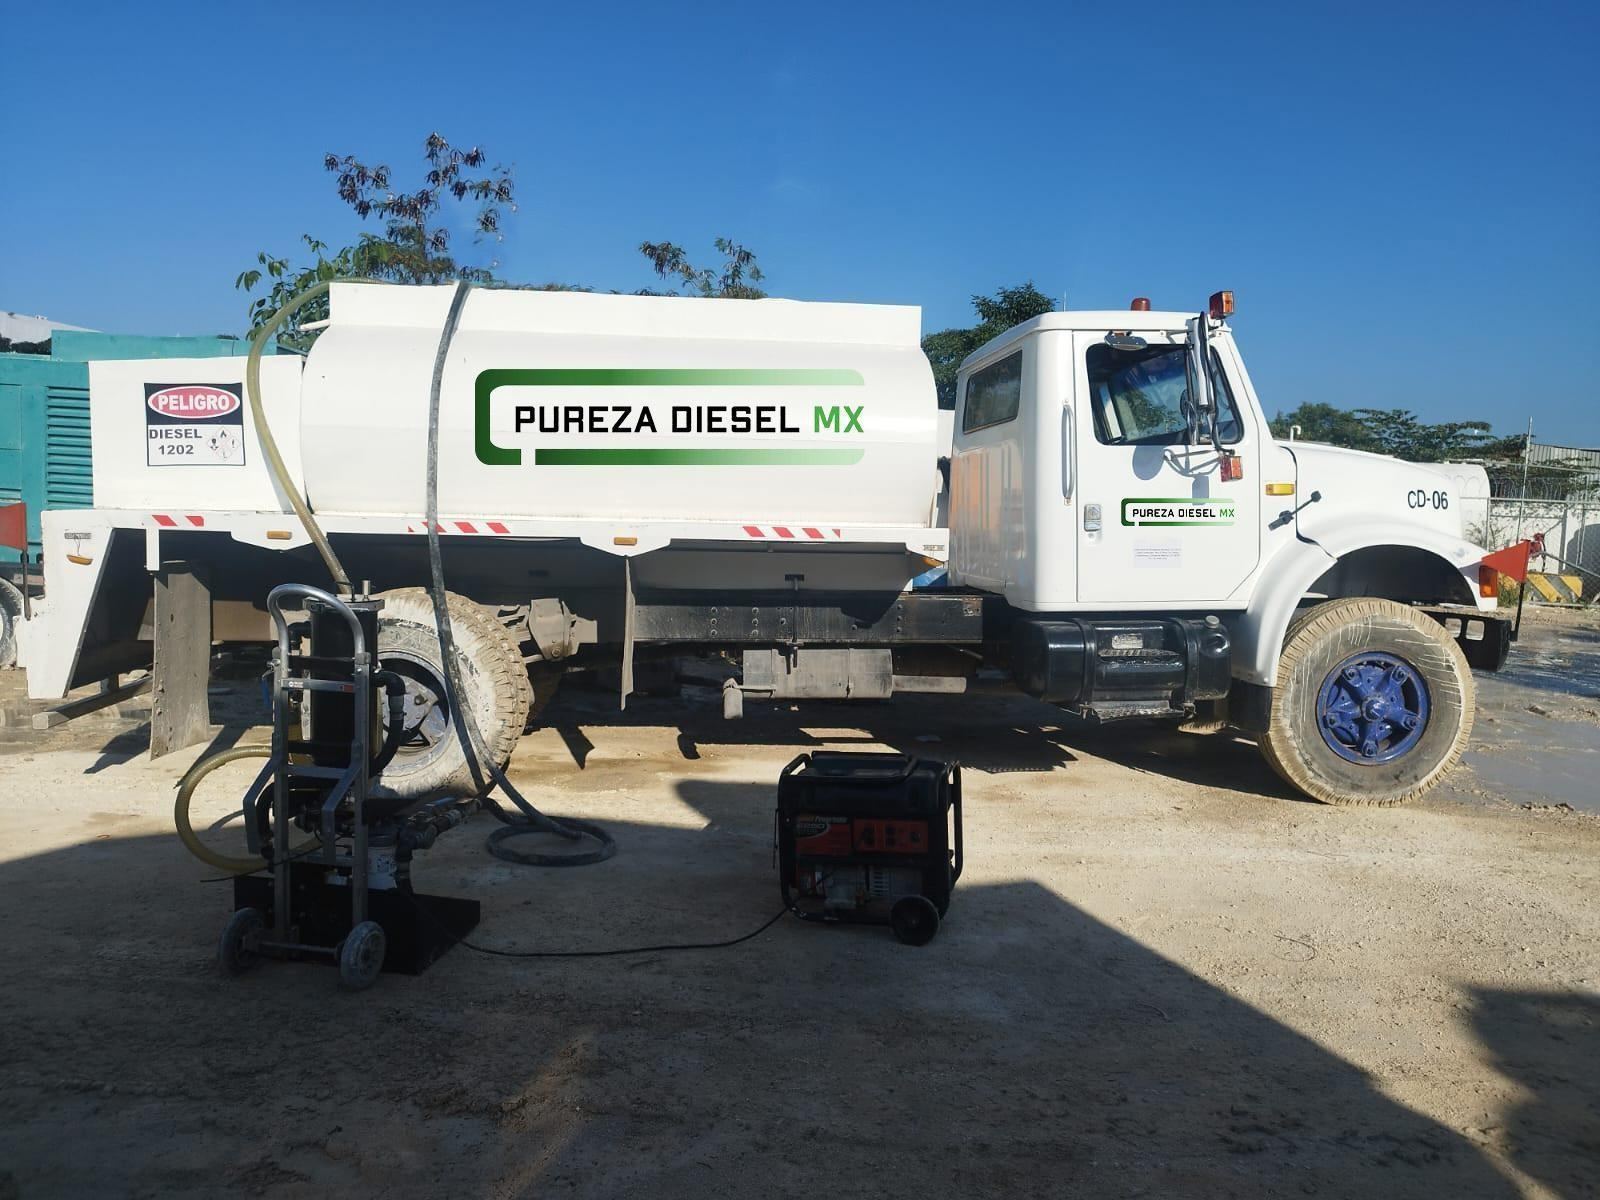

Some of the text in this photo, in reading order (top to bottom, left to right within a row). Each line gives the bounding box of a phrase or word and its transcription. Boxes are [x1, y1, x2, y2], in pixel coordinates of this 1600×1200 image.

[157, 394, 230, 411] PELIGRO
[514, 405, 865, 433] PUREZA DIESEL MX
[149, 428, 203, 439] DIESEL
[158, 444, 195, 455] 1202
[1407, 489, 1449, 510] CD-06
[1132, 508, 1235, 518] PUREZA DIESEL MX
